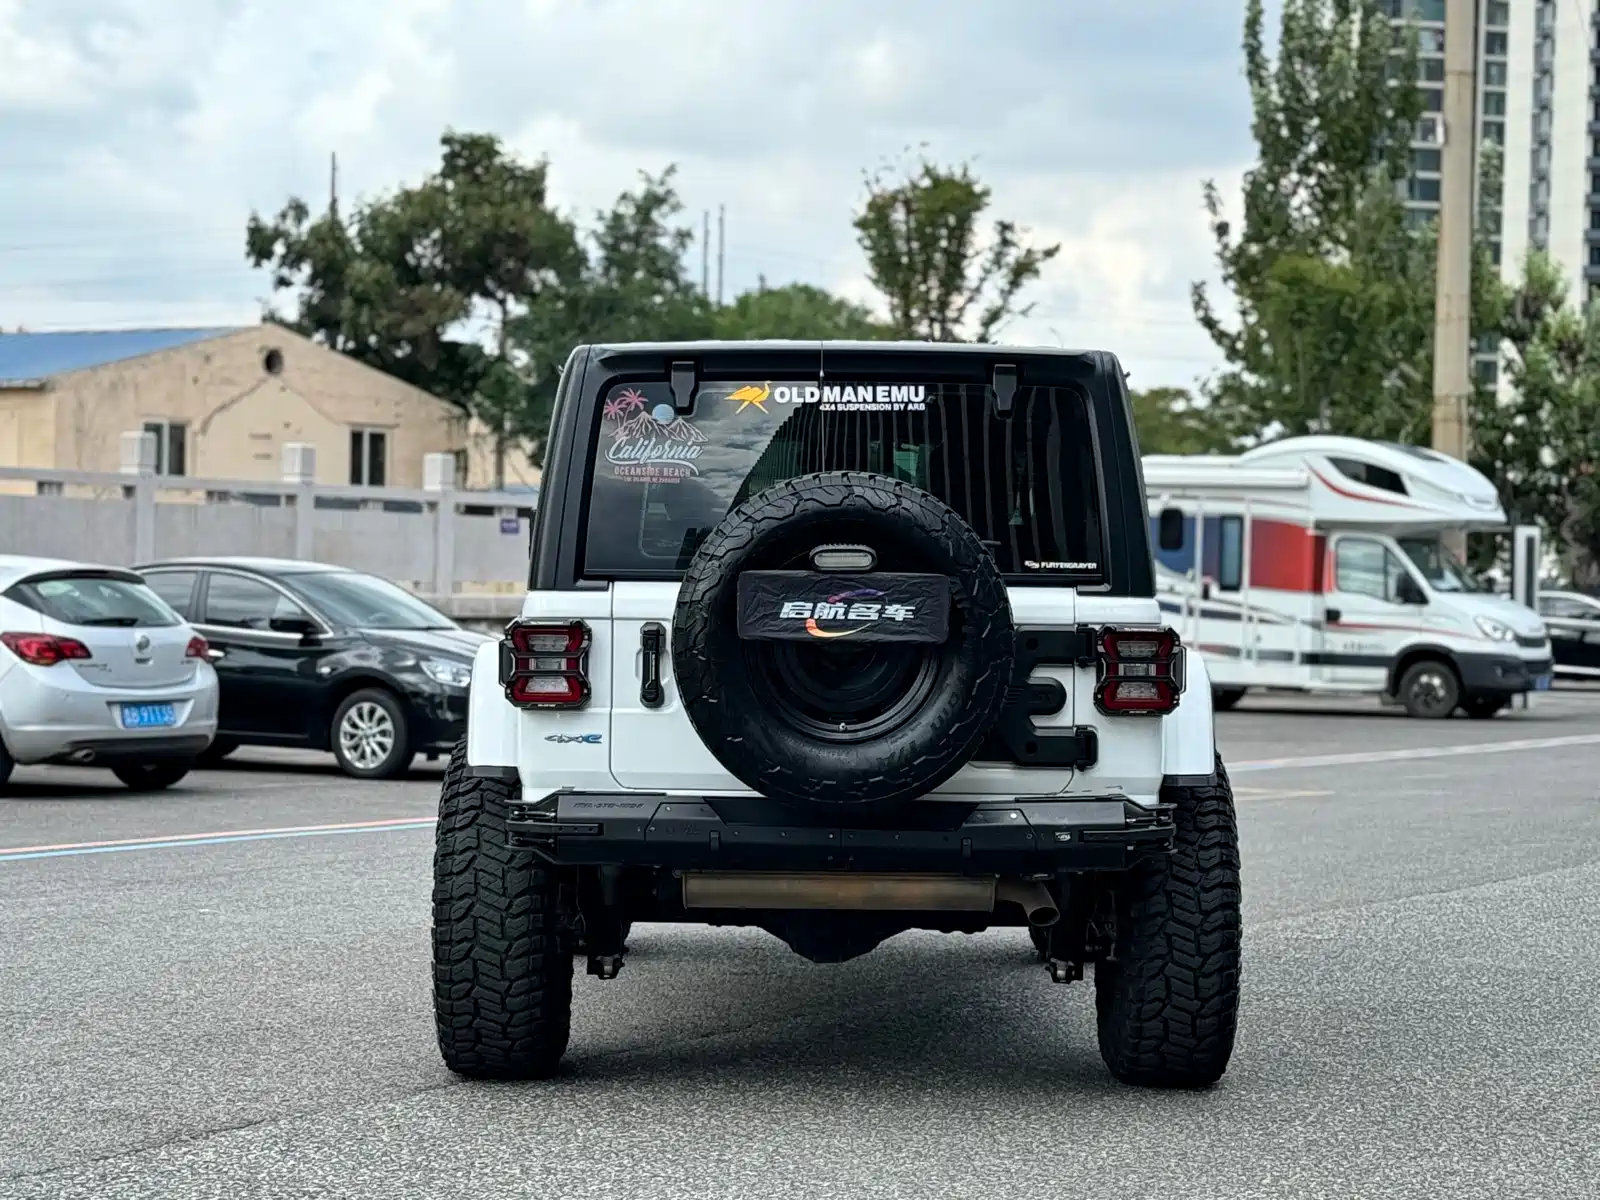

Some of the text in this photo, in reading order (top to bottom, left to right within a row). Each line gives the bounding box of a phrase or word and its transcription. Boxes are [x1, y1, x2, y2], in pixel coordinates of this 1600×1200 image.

[774, 386, 925, 404] OLD MAN EMU
[837, 403, 892, 412] SUSPENSION
[893, 403, 905, 412] BY
[609, 436, 703, 464] California
[614, 466, 691, 478] OCEANSIDE BEACH
[779, 601, 916, 621] 启航名车
